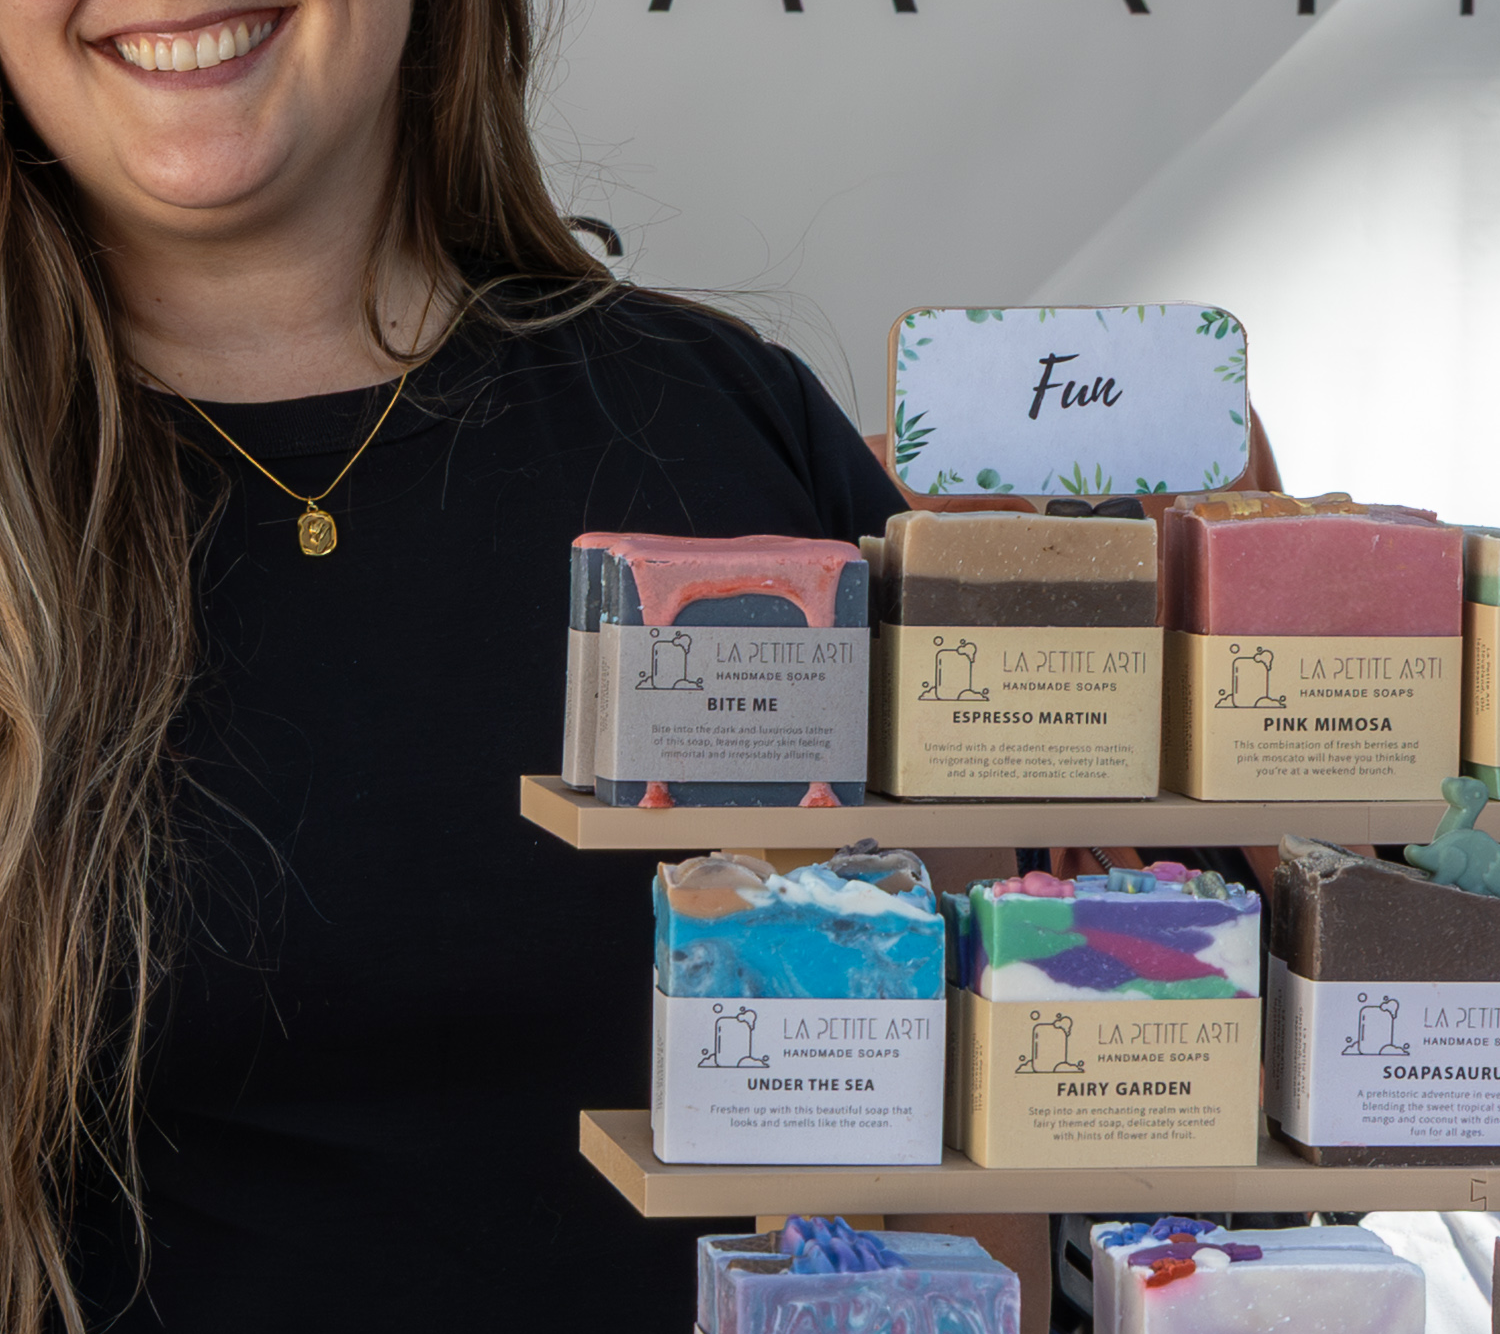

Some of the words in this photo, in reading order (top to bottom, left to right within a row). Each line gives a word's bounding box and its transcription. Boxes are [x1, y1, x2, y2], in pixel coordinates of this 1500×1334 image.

[1028, 352, 1123, 421] Fun
[707, 697, 746, 712] BITE
[752, 697, 778, 712] ME
[952, 710, 1034, 724] ESPRESSO
[1038, 711, 1107, 725] MARTINI
[1263, 717, 1308, 732] PINK
[1314, 717, 1393, 732] MIMOSA
[747, 1078, 804, 1091] UNDER
[808, 1078, 839, 1091] THE
[844, 1078, 875, 1092] SEA
[1057, 1082, 1109, 1097] FAIRY
[1115, 1081, 1191, 1096] GARDEN
